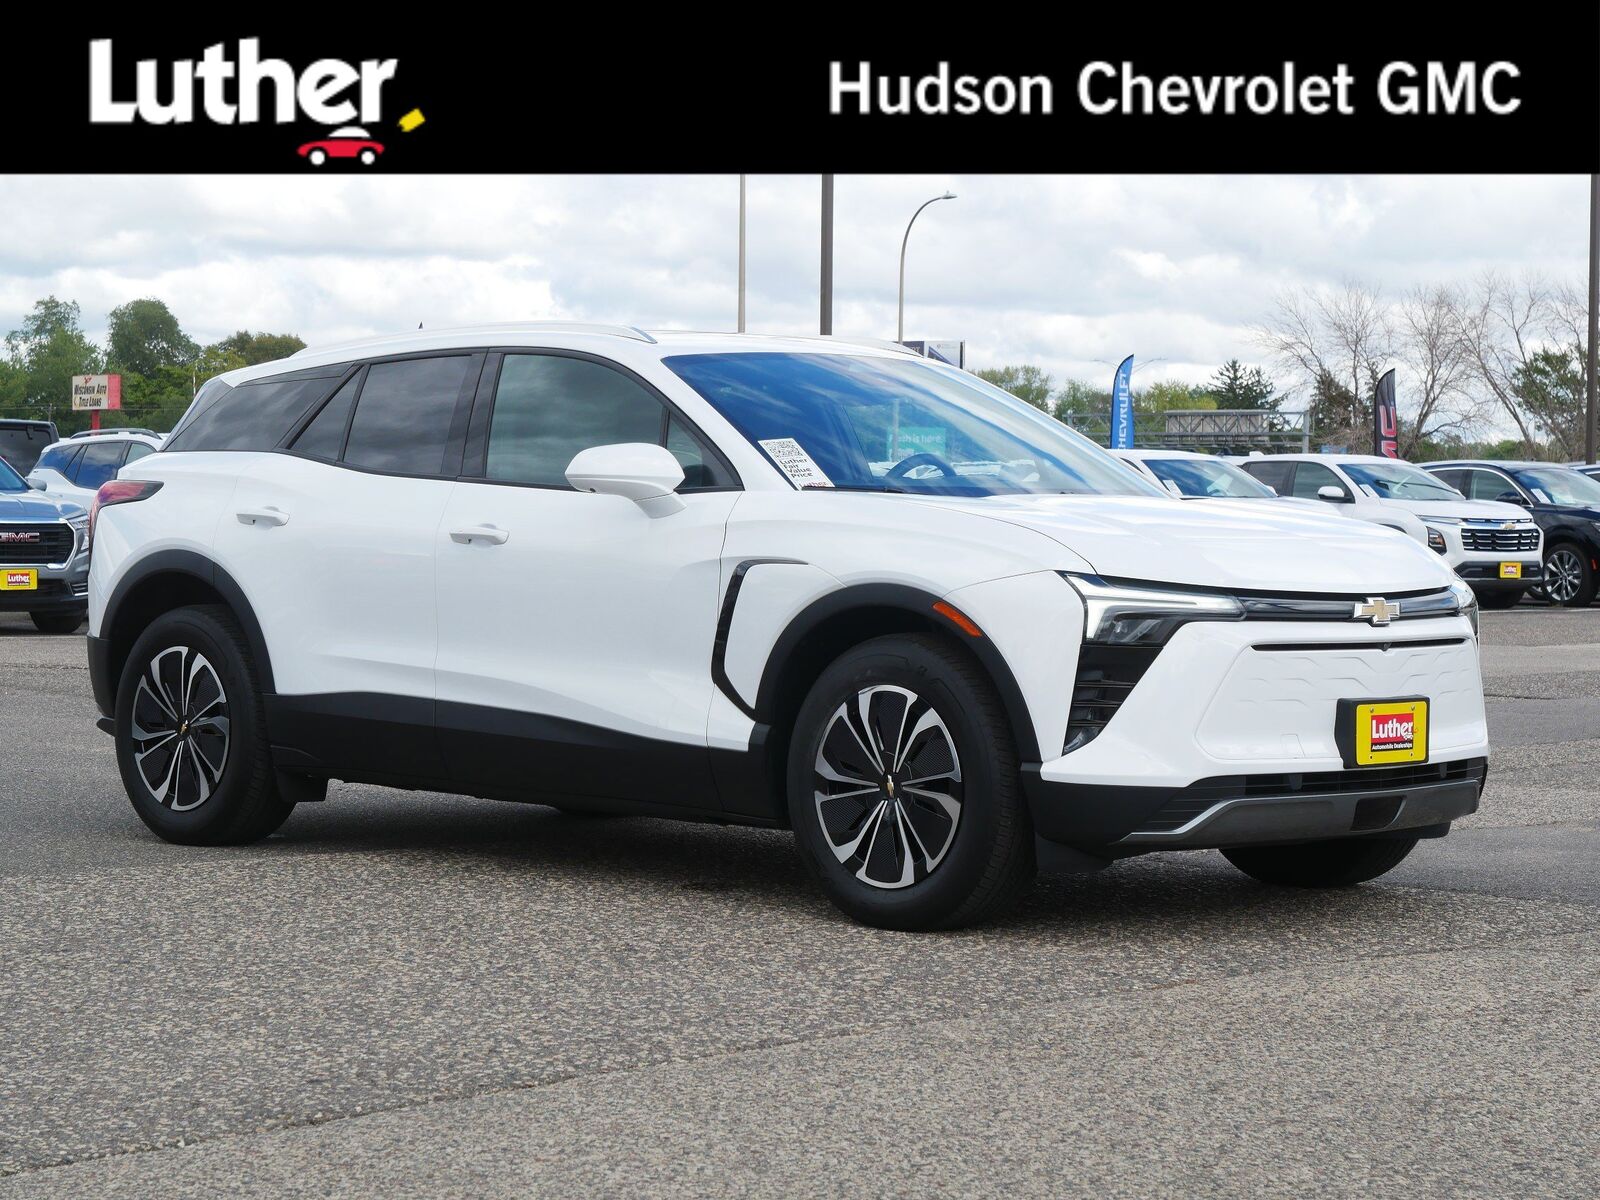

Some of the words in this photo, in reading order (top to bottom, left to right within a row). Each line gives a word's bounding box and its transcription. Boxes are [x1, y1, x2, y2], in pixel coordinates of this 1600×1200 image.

[1118, 369, 1129, 450] HEVROLET
[8, 574, 30, 582] Luther
[1372, 718, 1414, 739] Luther
